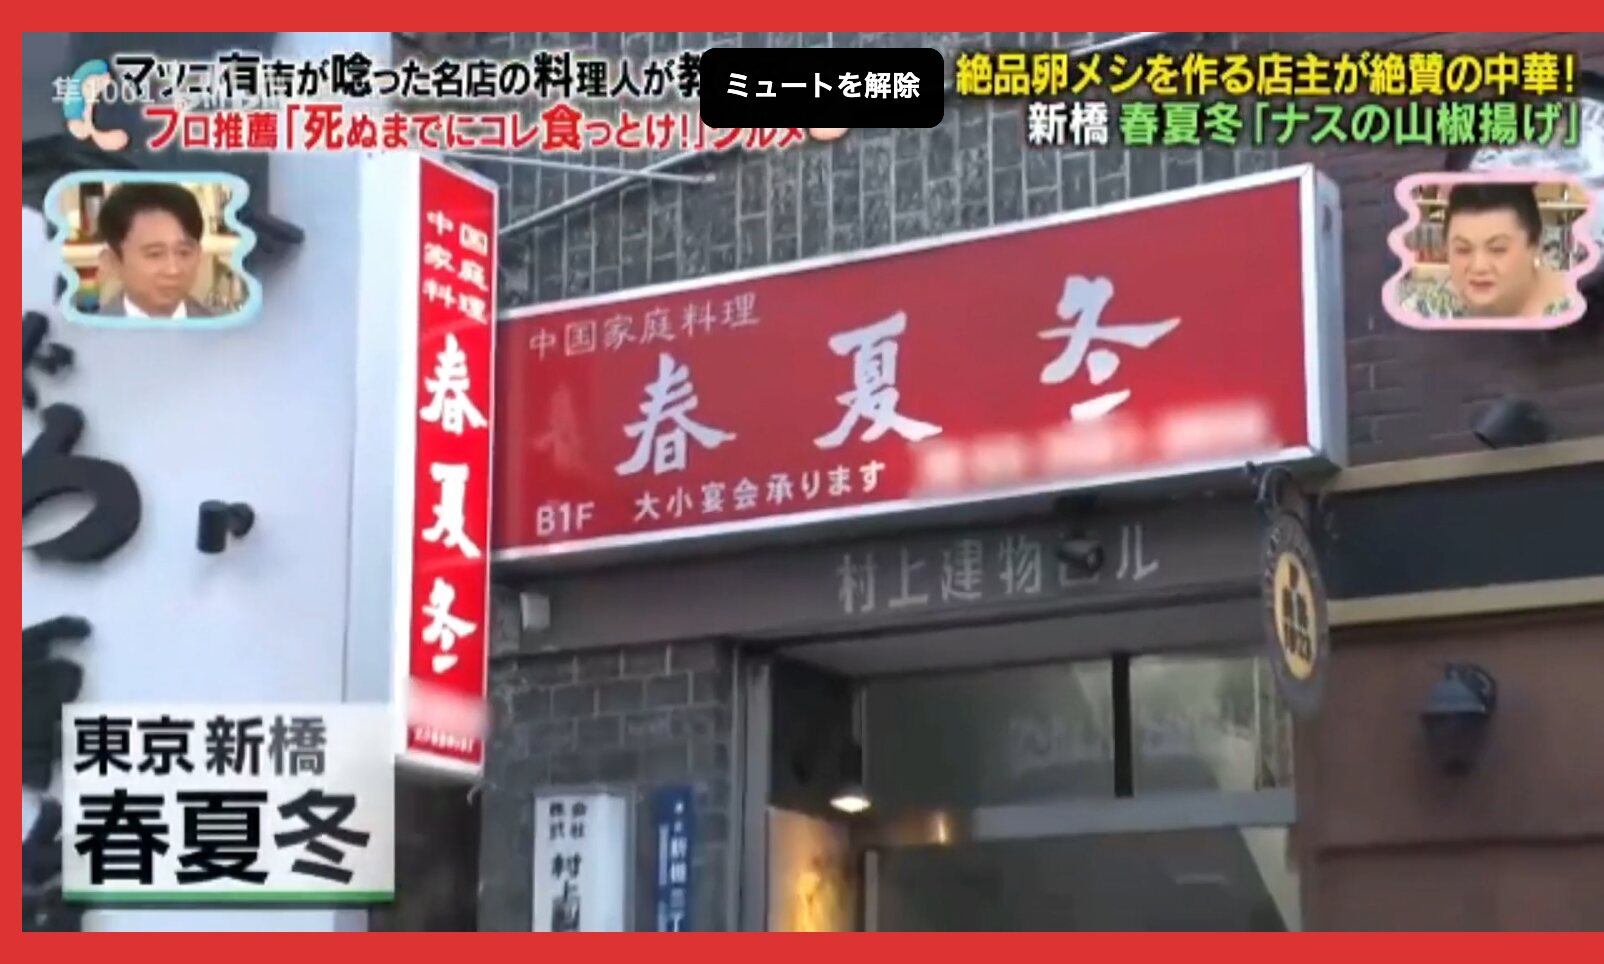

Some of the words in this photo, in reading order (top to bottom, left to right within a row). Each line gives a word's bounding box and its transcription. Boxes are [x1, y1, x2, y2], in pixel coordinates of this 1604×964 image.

[529, 292, 760, 361] 中国家庭料理
[419, 332, 488, 674] 春夏冬
[536, 501, 595, 537] B1F
[633, 460, 886, 523] 大小宴会承ります
